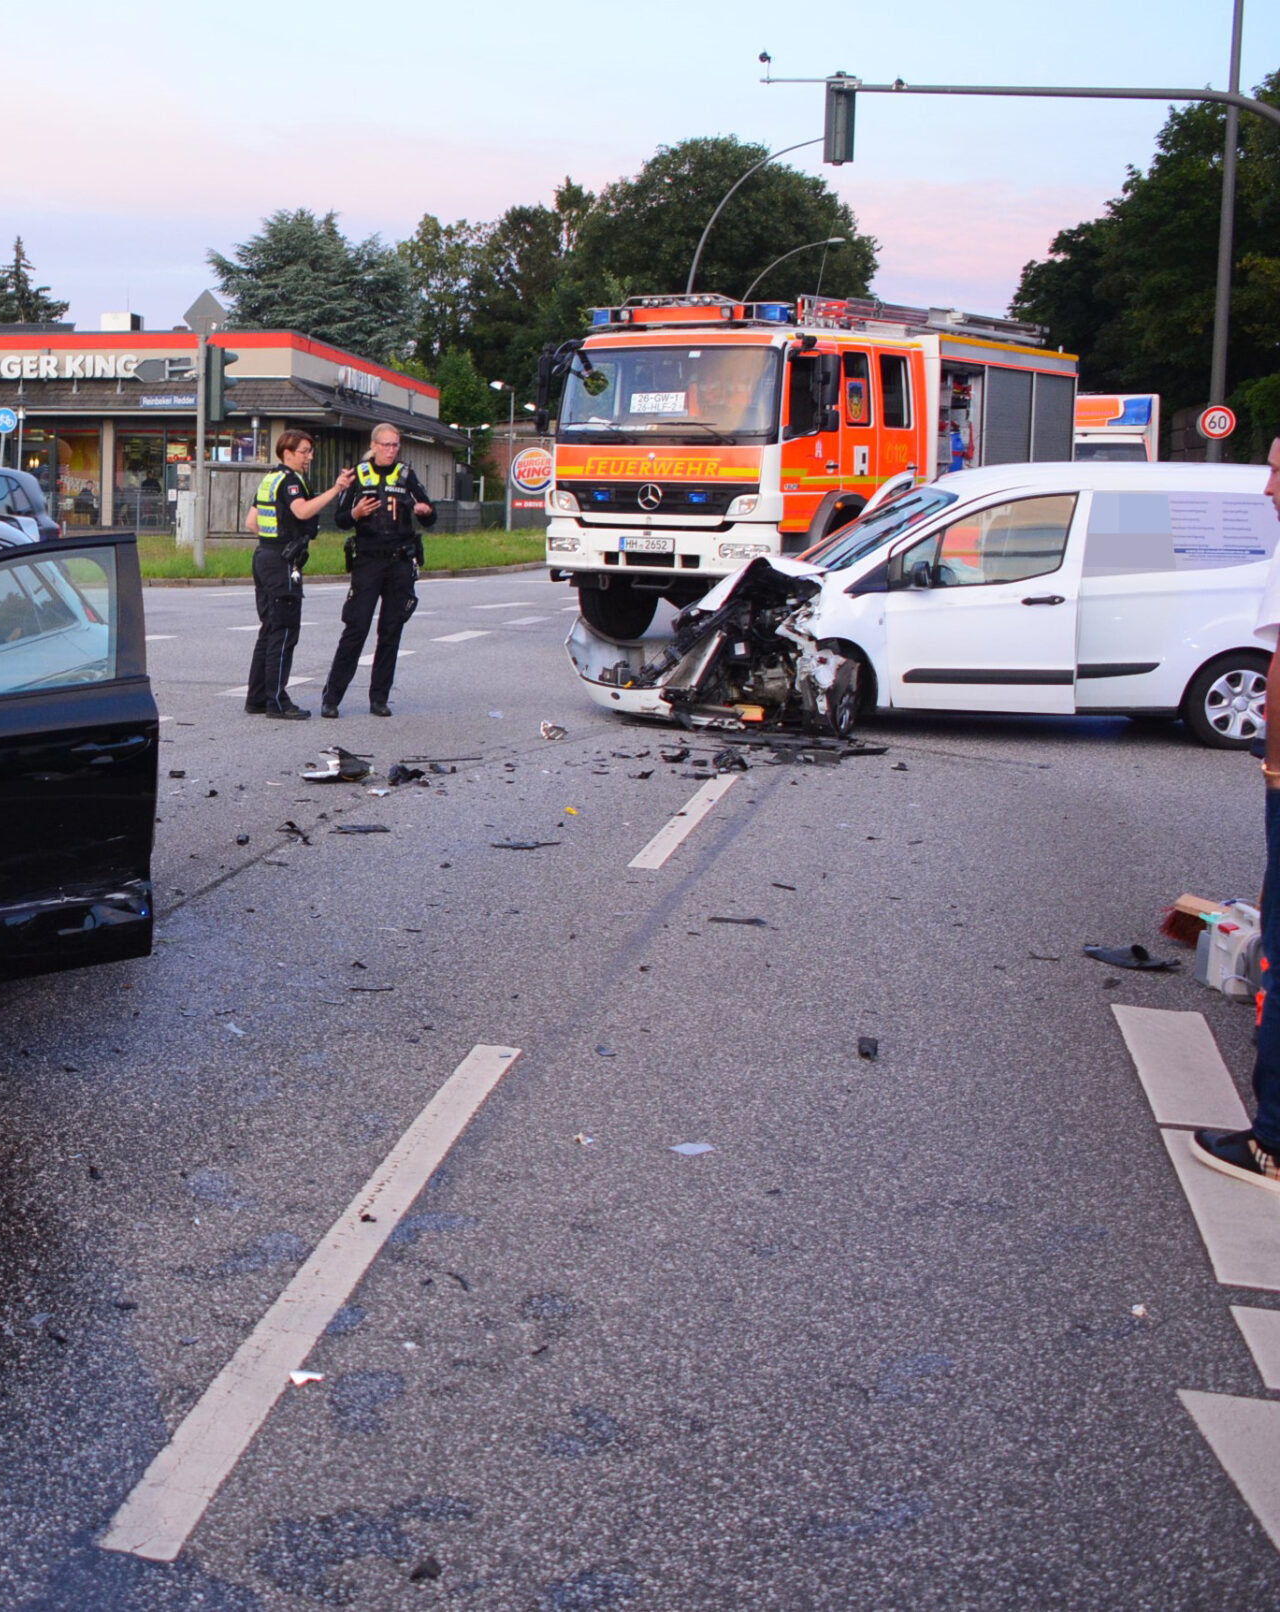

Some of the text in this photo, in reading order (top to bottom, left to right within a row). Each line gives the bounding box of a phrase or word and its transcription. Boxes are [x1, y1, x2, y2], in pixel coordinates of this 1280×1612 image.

[65, 353, 139, 379] KING
[637, 394, 679, 403] 26-GW-1
[1208, 415, 1227, 430] 60
[517, 458, 552, 468] BURGER
[585, 456, 721, 477] FEUERWEHR
[517, 465, 552, 480] KING
[384, 485, 407, 494] POLIZEI
[625, 540, 668, 550] HH 2652
